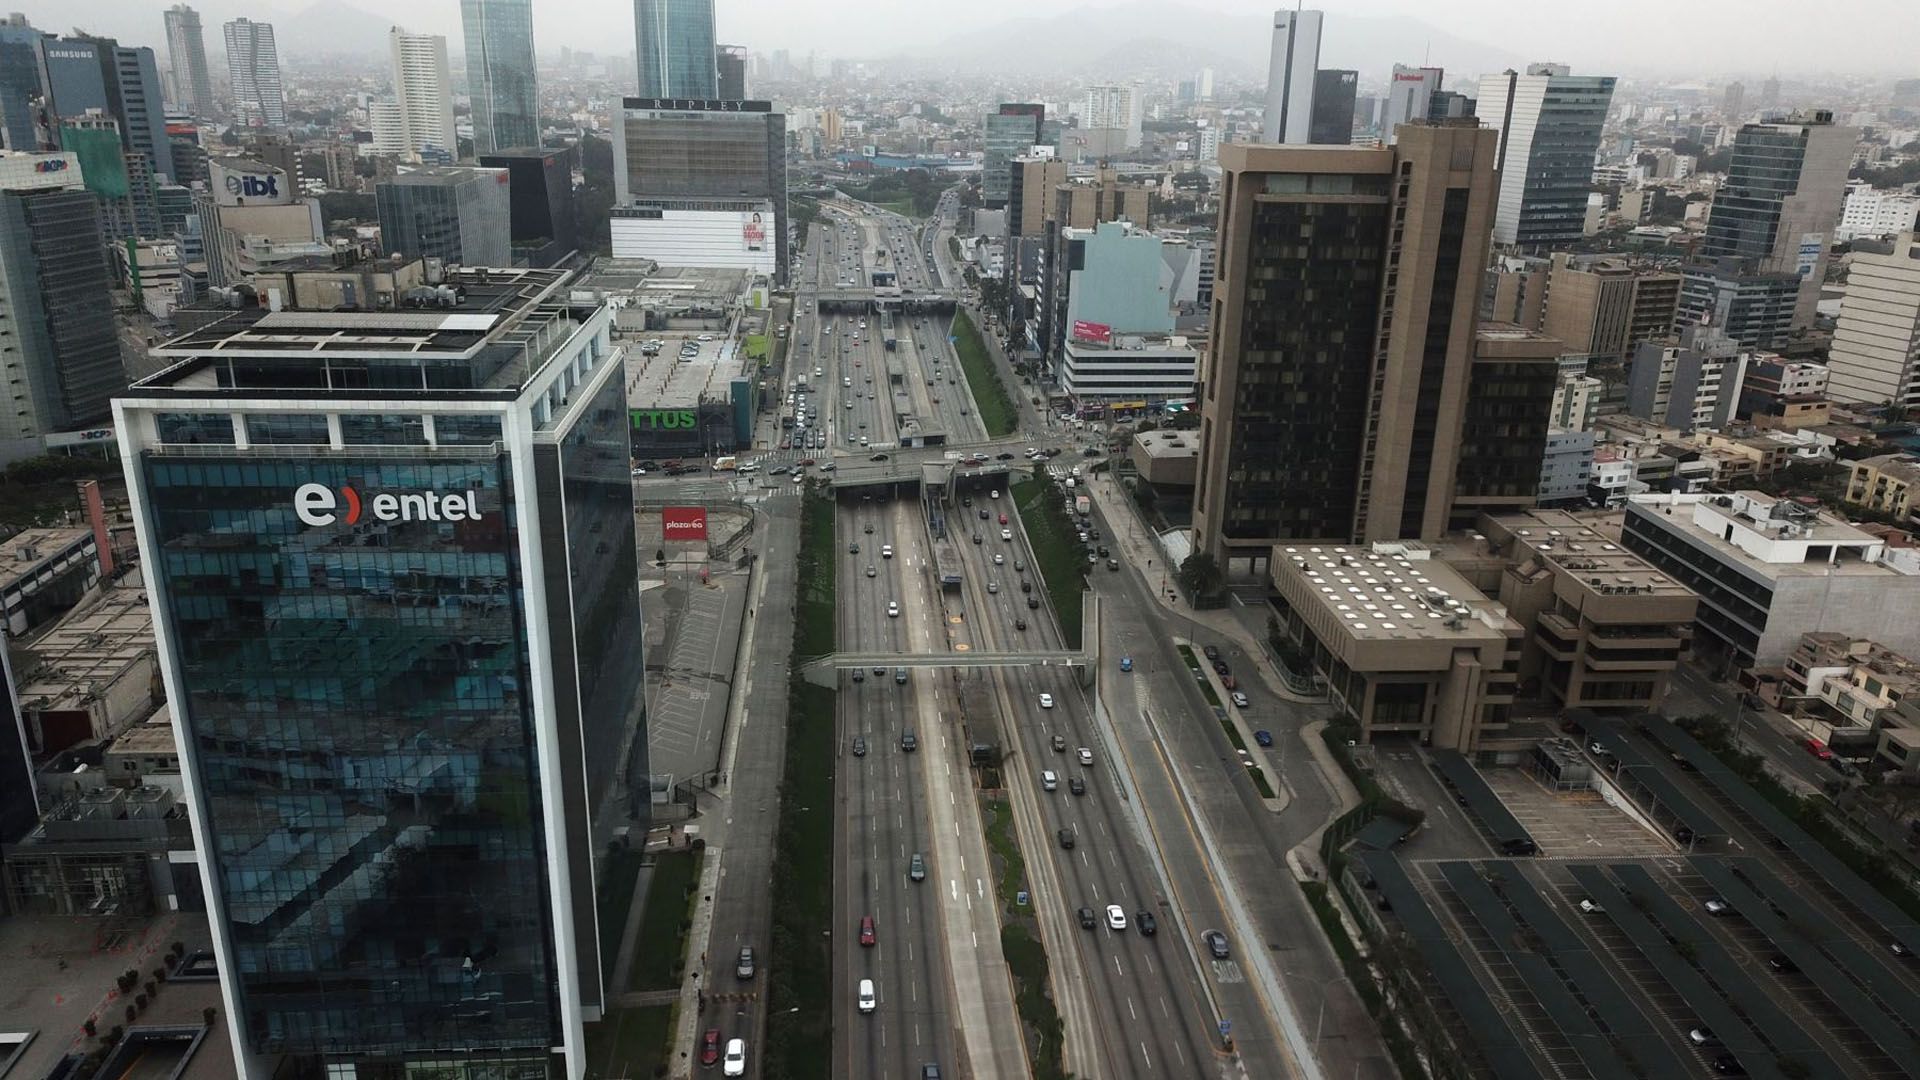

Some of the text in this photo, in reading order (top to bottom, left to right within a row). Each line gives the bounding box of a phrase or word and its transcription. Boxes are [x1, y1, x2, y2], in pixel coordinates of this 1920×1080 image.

[49, 50, 94, 58] SAMSUNG
[654, 99, 744, 111] RIPLEY
[242, 175, 279, 196] ibt
[372, 490, 482, 521] entel
